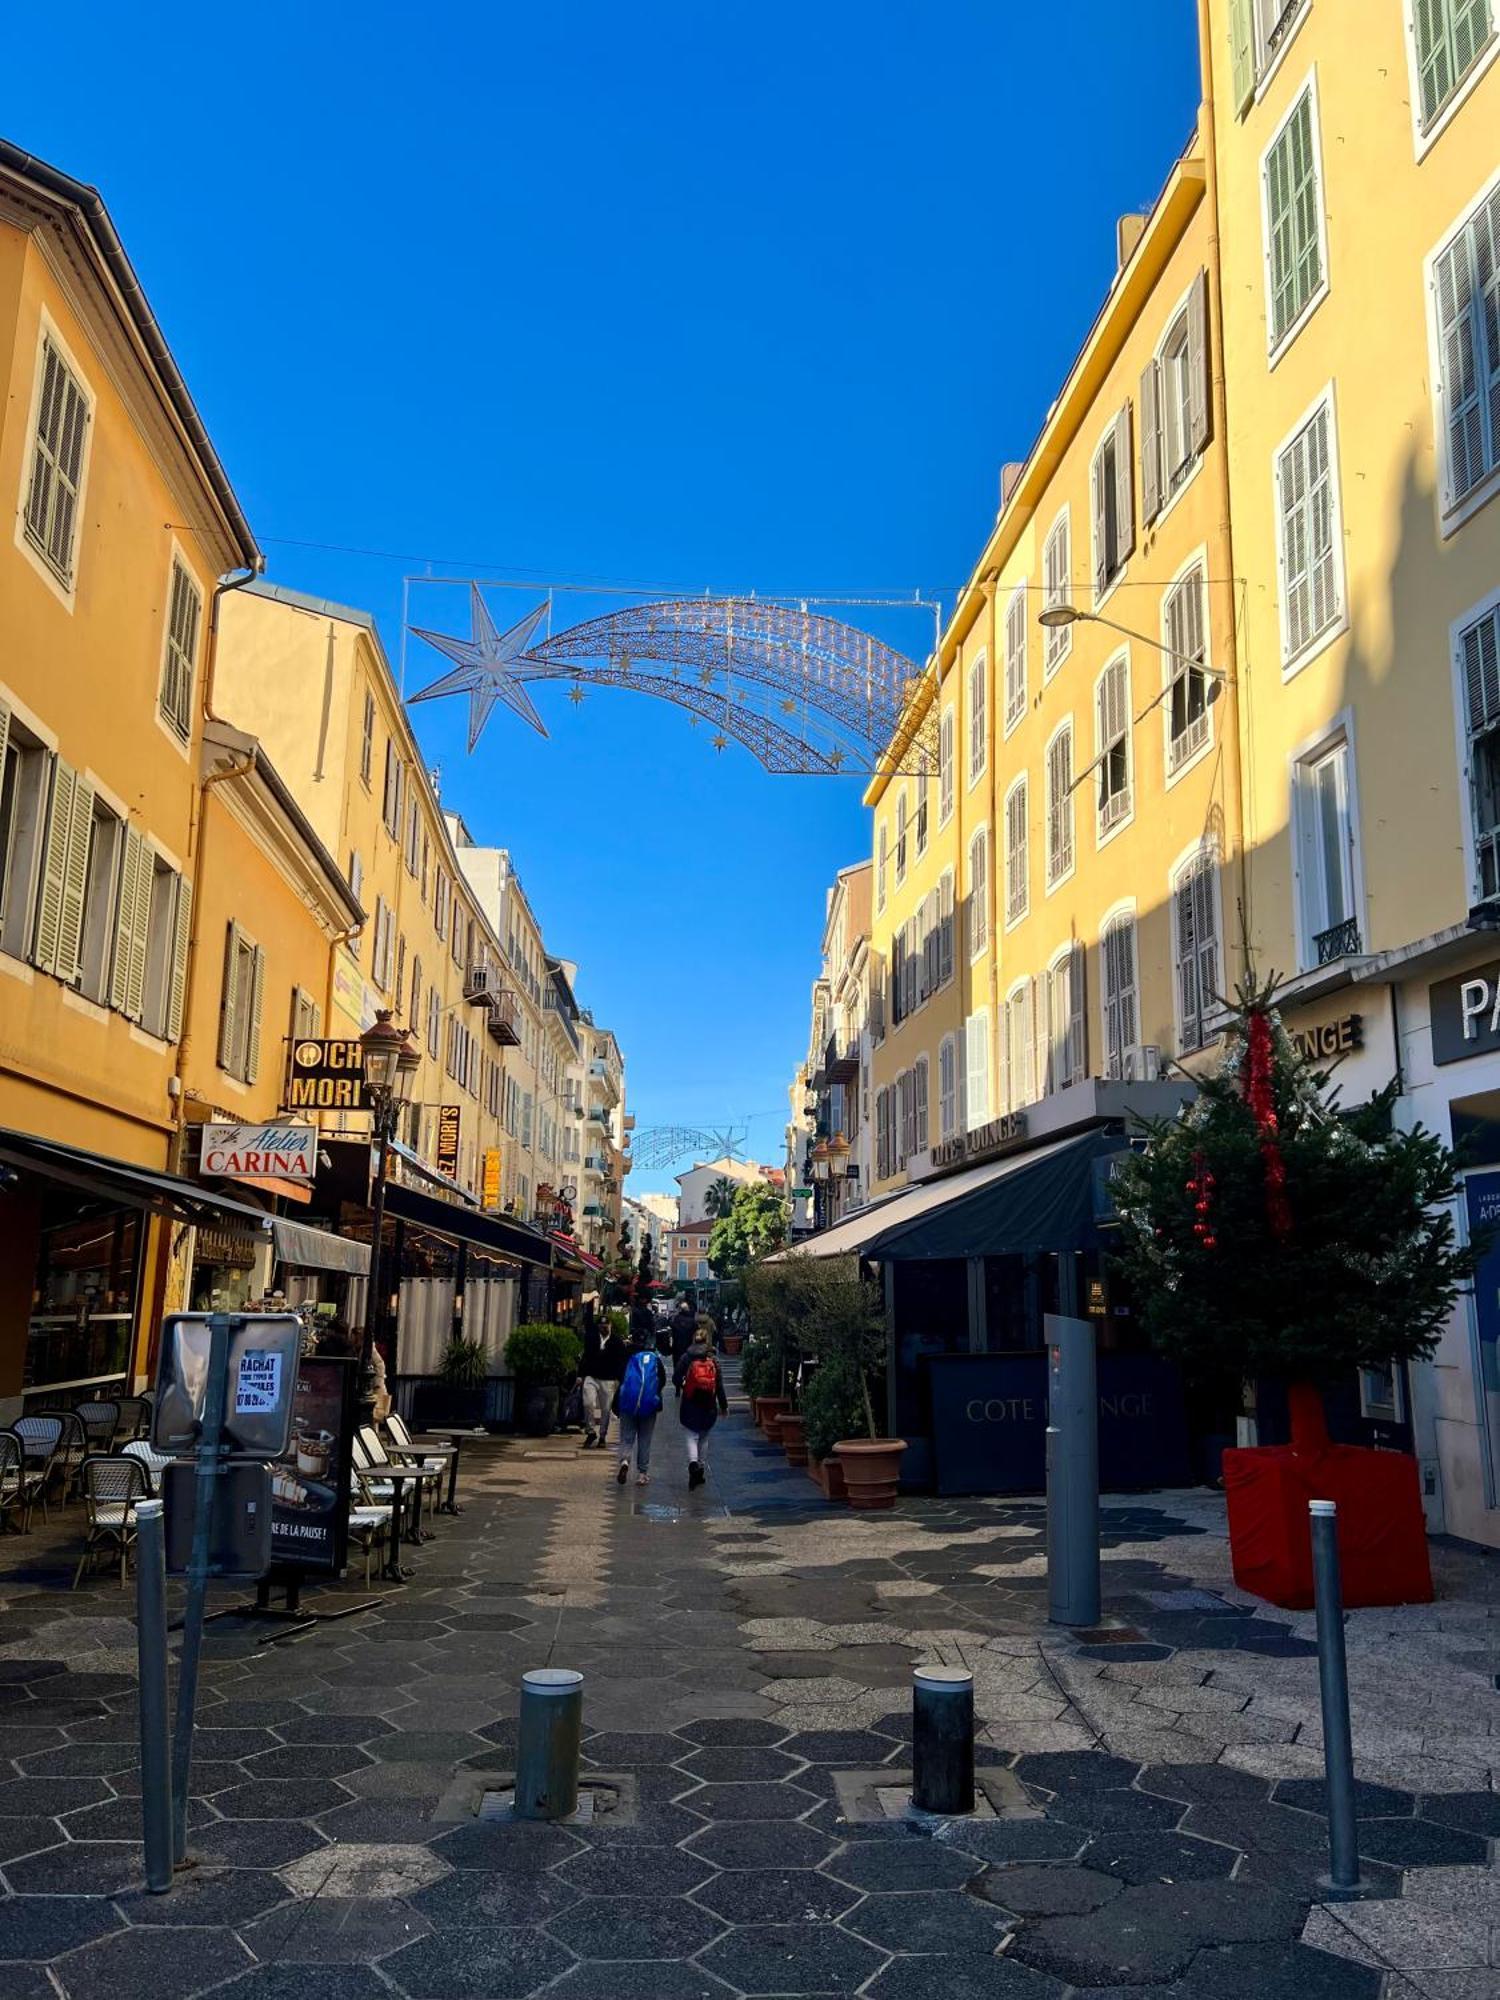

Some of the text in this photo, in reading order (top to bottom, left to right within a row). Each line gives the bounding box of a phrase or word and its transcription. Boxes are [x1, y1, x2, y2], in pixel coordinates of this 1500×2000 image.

[329, 1042, 361, 1068] CH
[291, 1078, 361, 1106] MORI
[240, 1128, 309, 1151] Atelier
[440, 1107, 459, 1155] MORI'S
[966, 1112, 1023, 1154] LOUNGE
[206, 1151, 308, 1174] CARINA
[241, 1358, 275, 1371] RACHAT
[966, 1398, 1035, 1422] COTE
[280, 1523, 289, 1536] DE
[290, 1525, 299, 1537] LA
